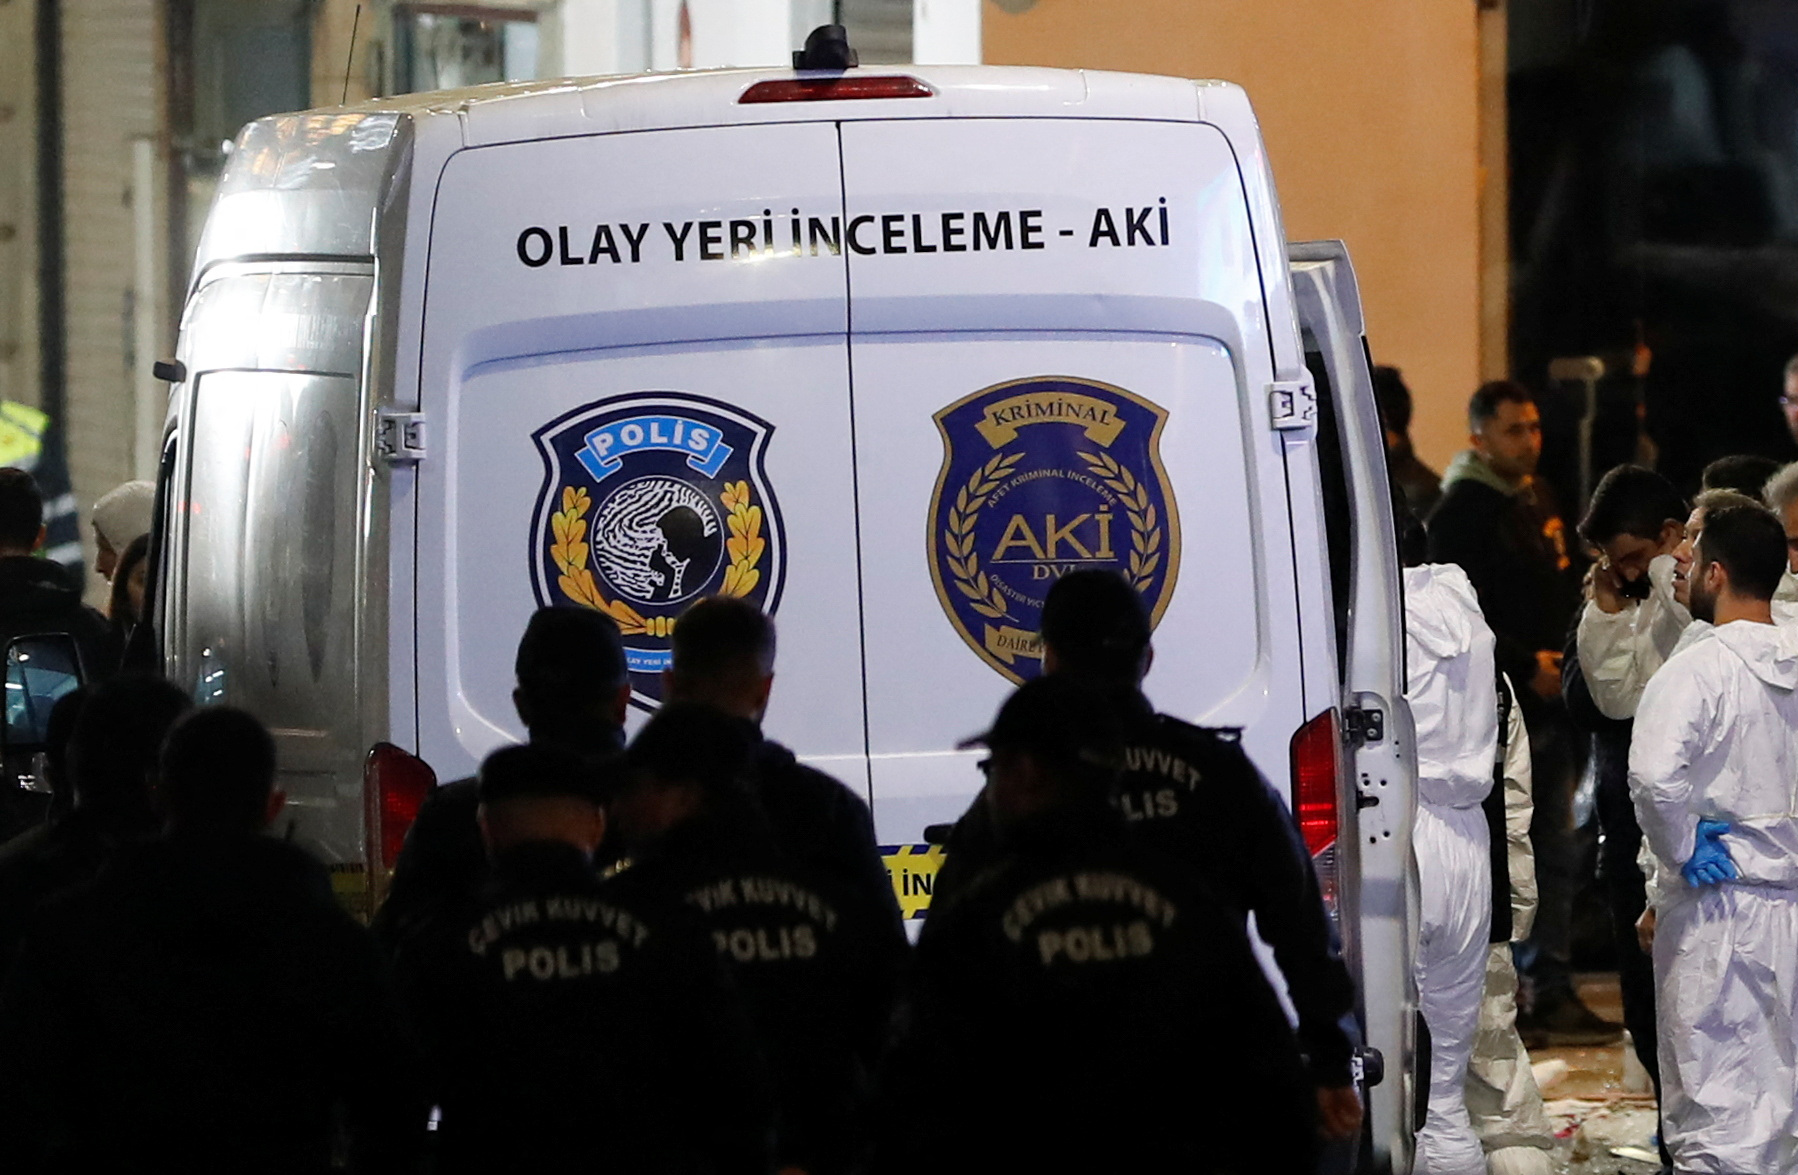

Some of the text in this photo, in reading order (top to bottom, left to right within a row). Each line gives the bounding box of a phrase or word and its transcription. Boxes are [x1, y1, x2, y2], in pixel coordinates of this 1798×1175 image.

[517, 222, 650, 268] OLAY
[663, 208, 774, 261] YERİ
[790, 207, 1045, 258] İNCELEME
[1088, 197, 1170, 248] AKİ
[992, 398, 1110, 426] KRİMİNAL
[592, 420, 710, 457] POLİS
[1067, 469, 1118, 506] İNCELEME
[992, 504, 1115, 560] AKİ
[1125, 746, 1203, 793] UVVET
